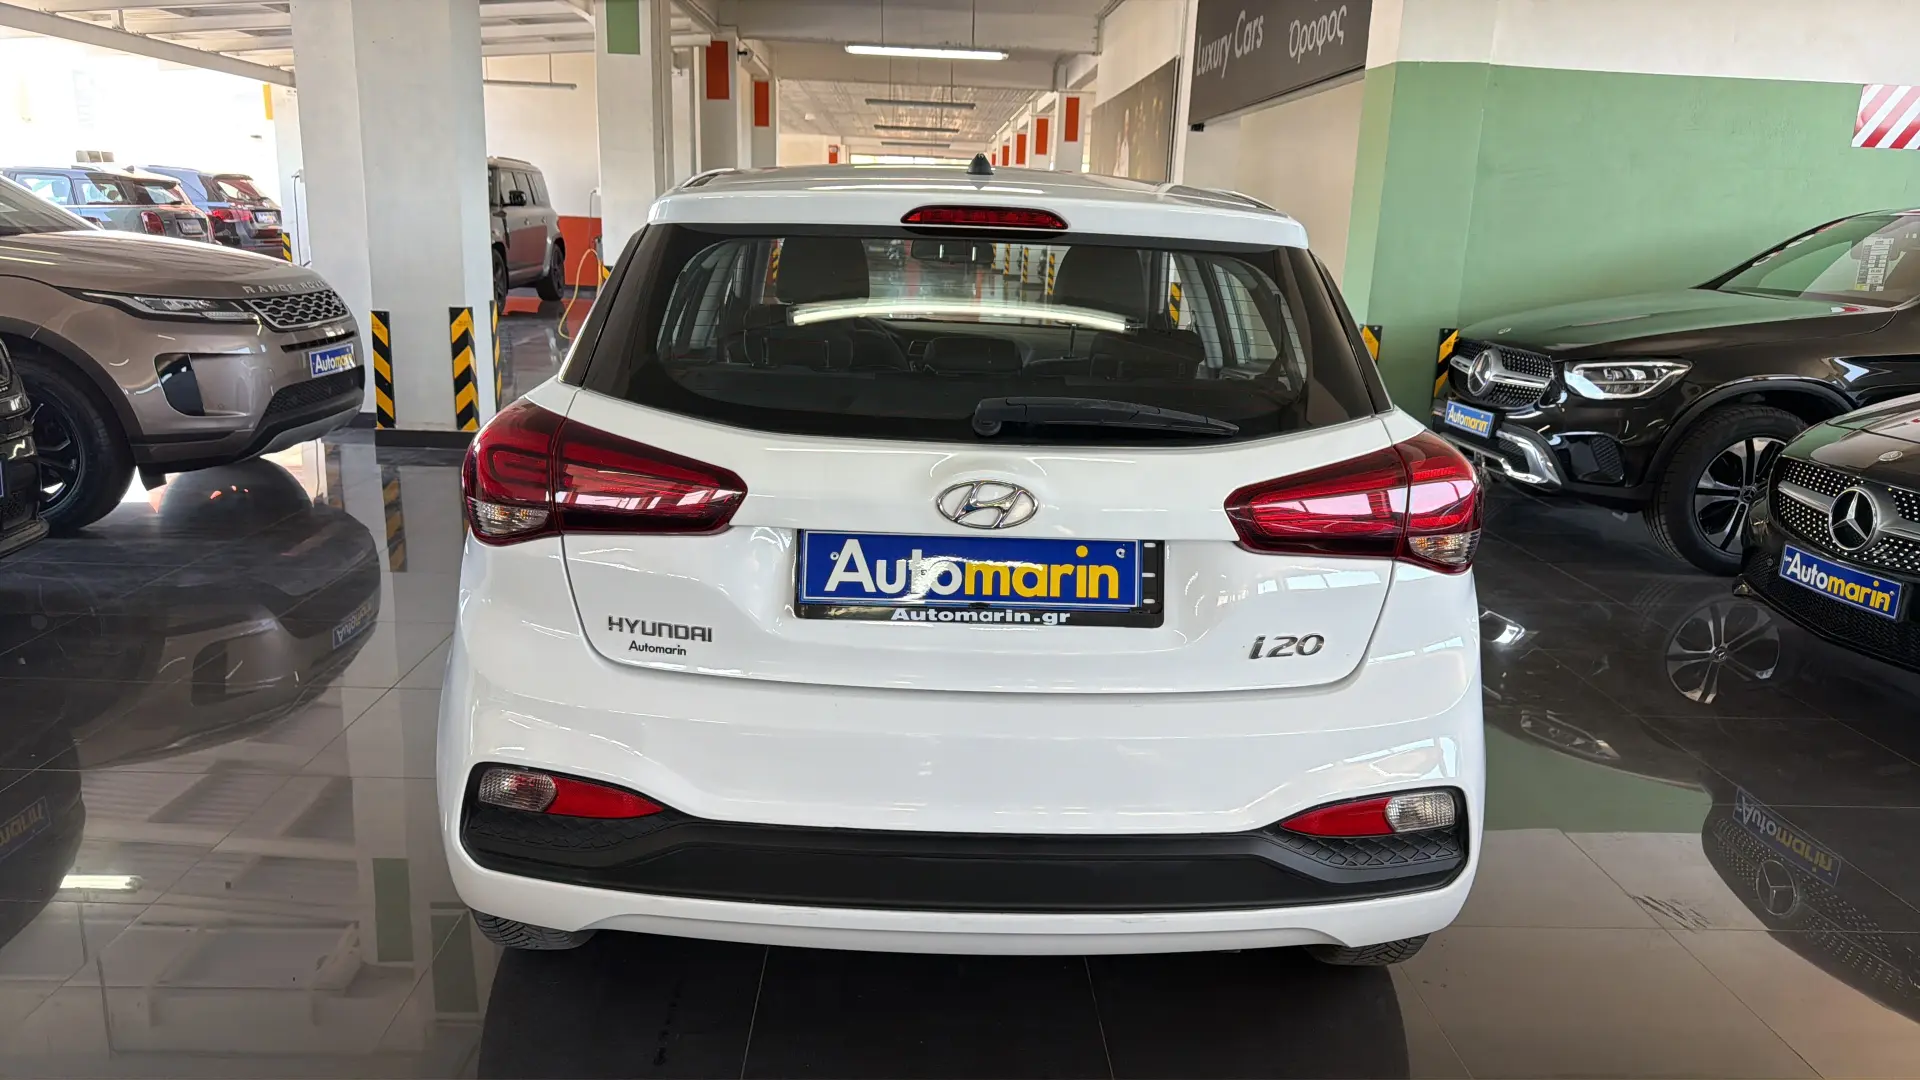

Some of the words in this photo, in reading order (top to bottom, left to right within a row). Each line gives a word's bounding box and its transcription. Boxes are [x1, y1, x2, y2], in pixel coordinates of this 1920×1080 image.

[1196, 32, 1232, 79] Luxury
[1234, 10, 1264, 58] Cars
[242, 283, 296, 294] RANGE
[824, 539, 1119, 599] Automarin
[1786, 552, 1891, 611] Automarin
[608, 615, 712, 642] HYUNDAI
[891, 607, 1071, 625] Automarin.gr
[629, 640, 687, 656] Automarin
[1249, 633, 1325, 659] i20
